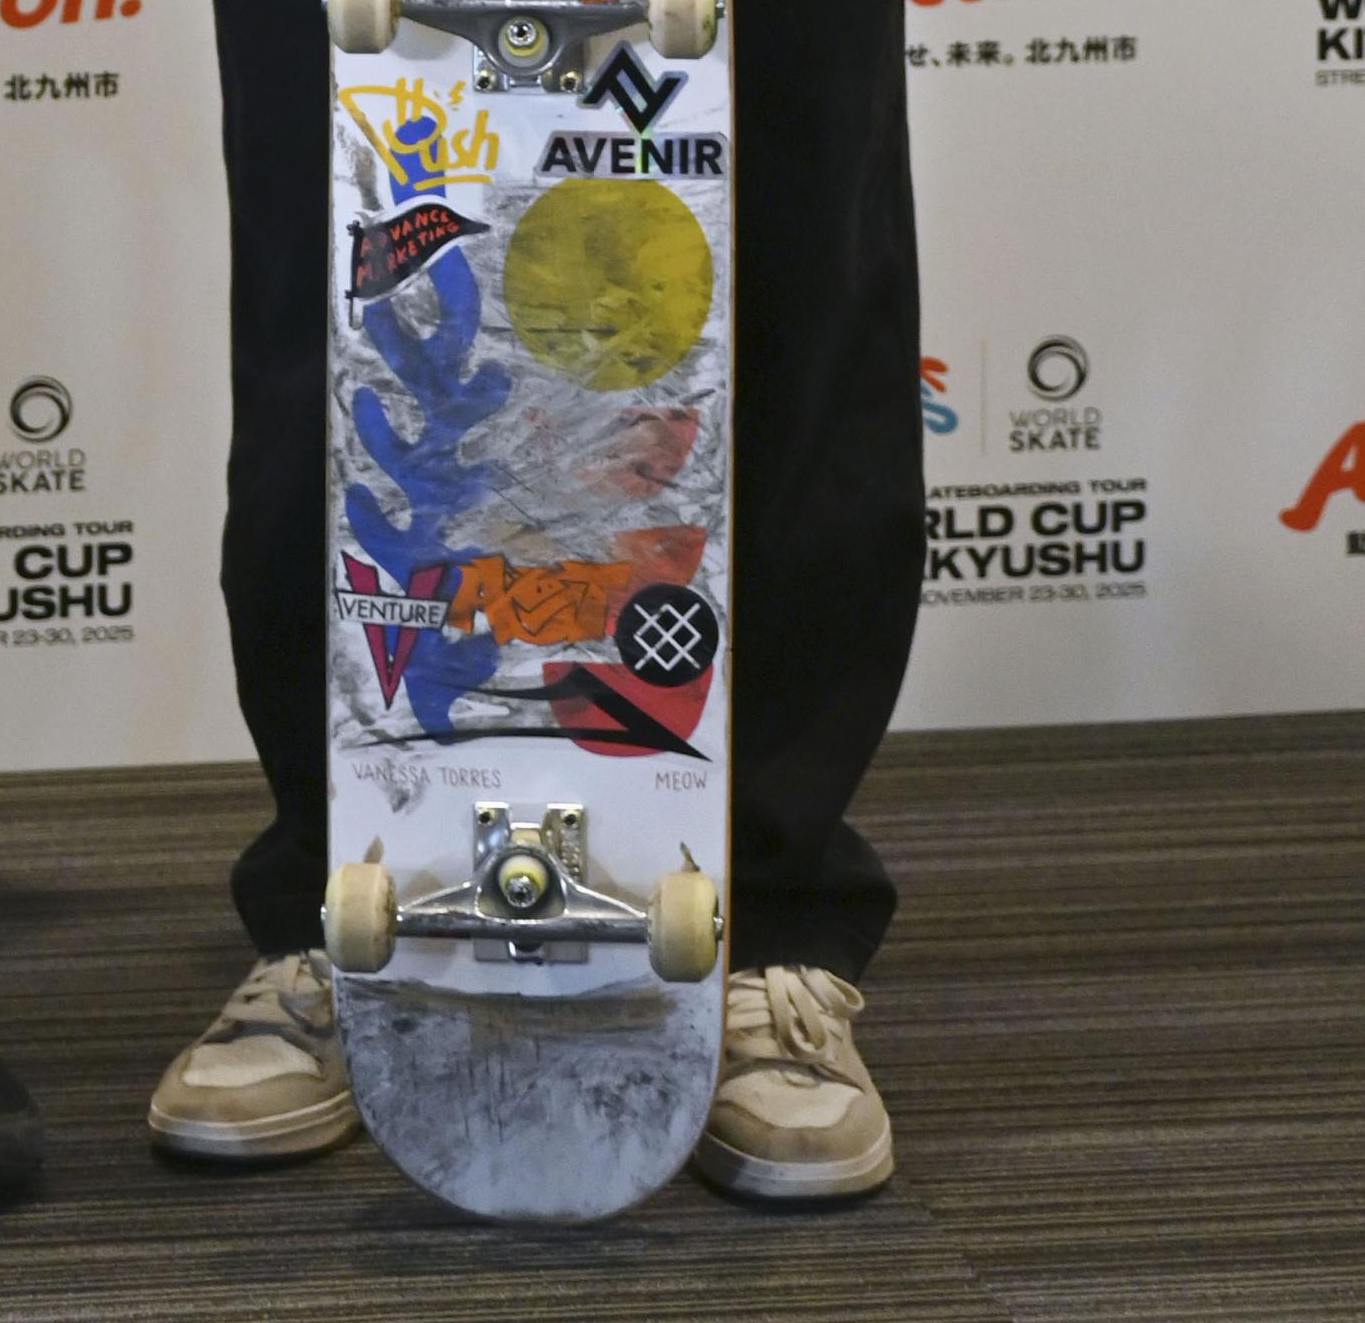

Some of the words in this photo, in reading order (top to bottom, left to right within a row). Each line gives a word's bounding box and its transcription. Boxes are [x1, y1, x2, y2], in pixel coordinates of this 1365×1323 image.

[1025, 35, 1138, 65] 北九州市
[4, 71, 120, 103] 北九州市
[540, 137, 724, 175] AVENIR
[1008, 407, 1102, 428] WORLD
[1008, 428, 1102, 454] SKATE
[928, 480, 1080, 499] ATEBOARDING
[1089, 478, 1147, 493] TOUR
[74, 520, 133, 536] TOUR
[1031, 501, 1146, 536] CUP
[14, 542, 133, 580] CUP
[925, 540, 1145, 580] KYUSHU
[921, 586, 1024, 604] OVEMBER
[341, 598, 442, 626] VENTURE
[353, 764, 431, 785] VANESSA
[437, 766, 502, 788] TORRES
[654, 770, 708, 791] MEOW
